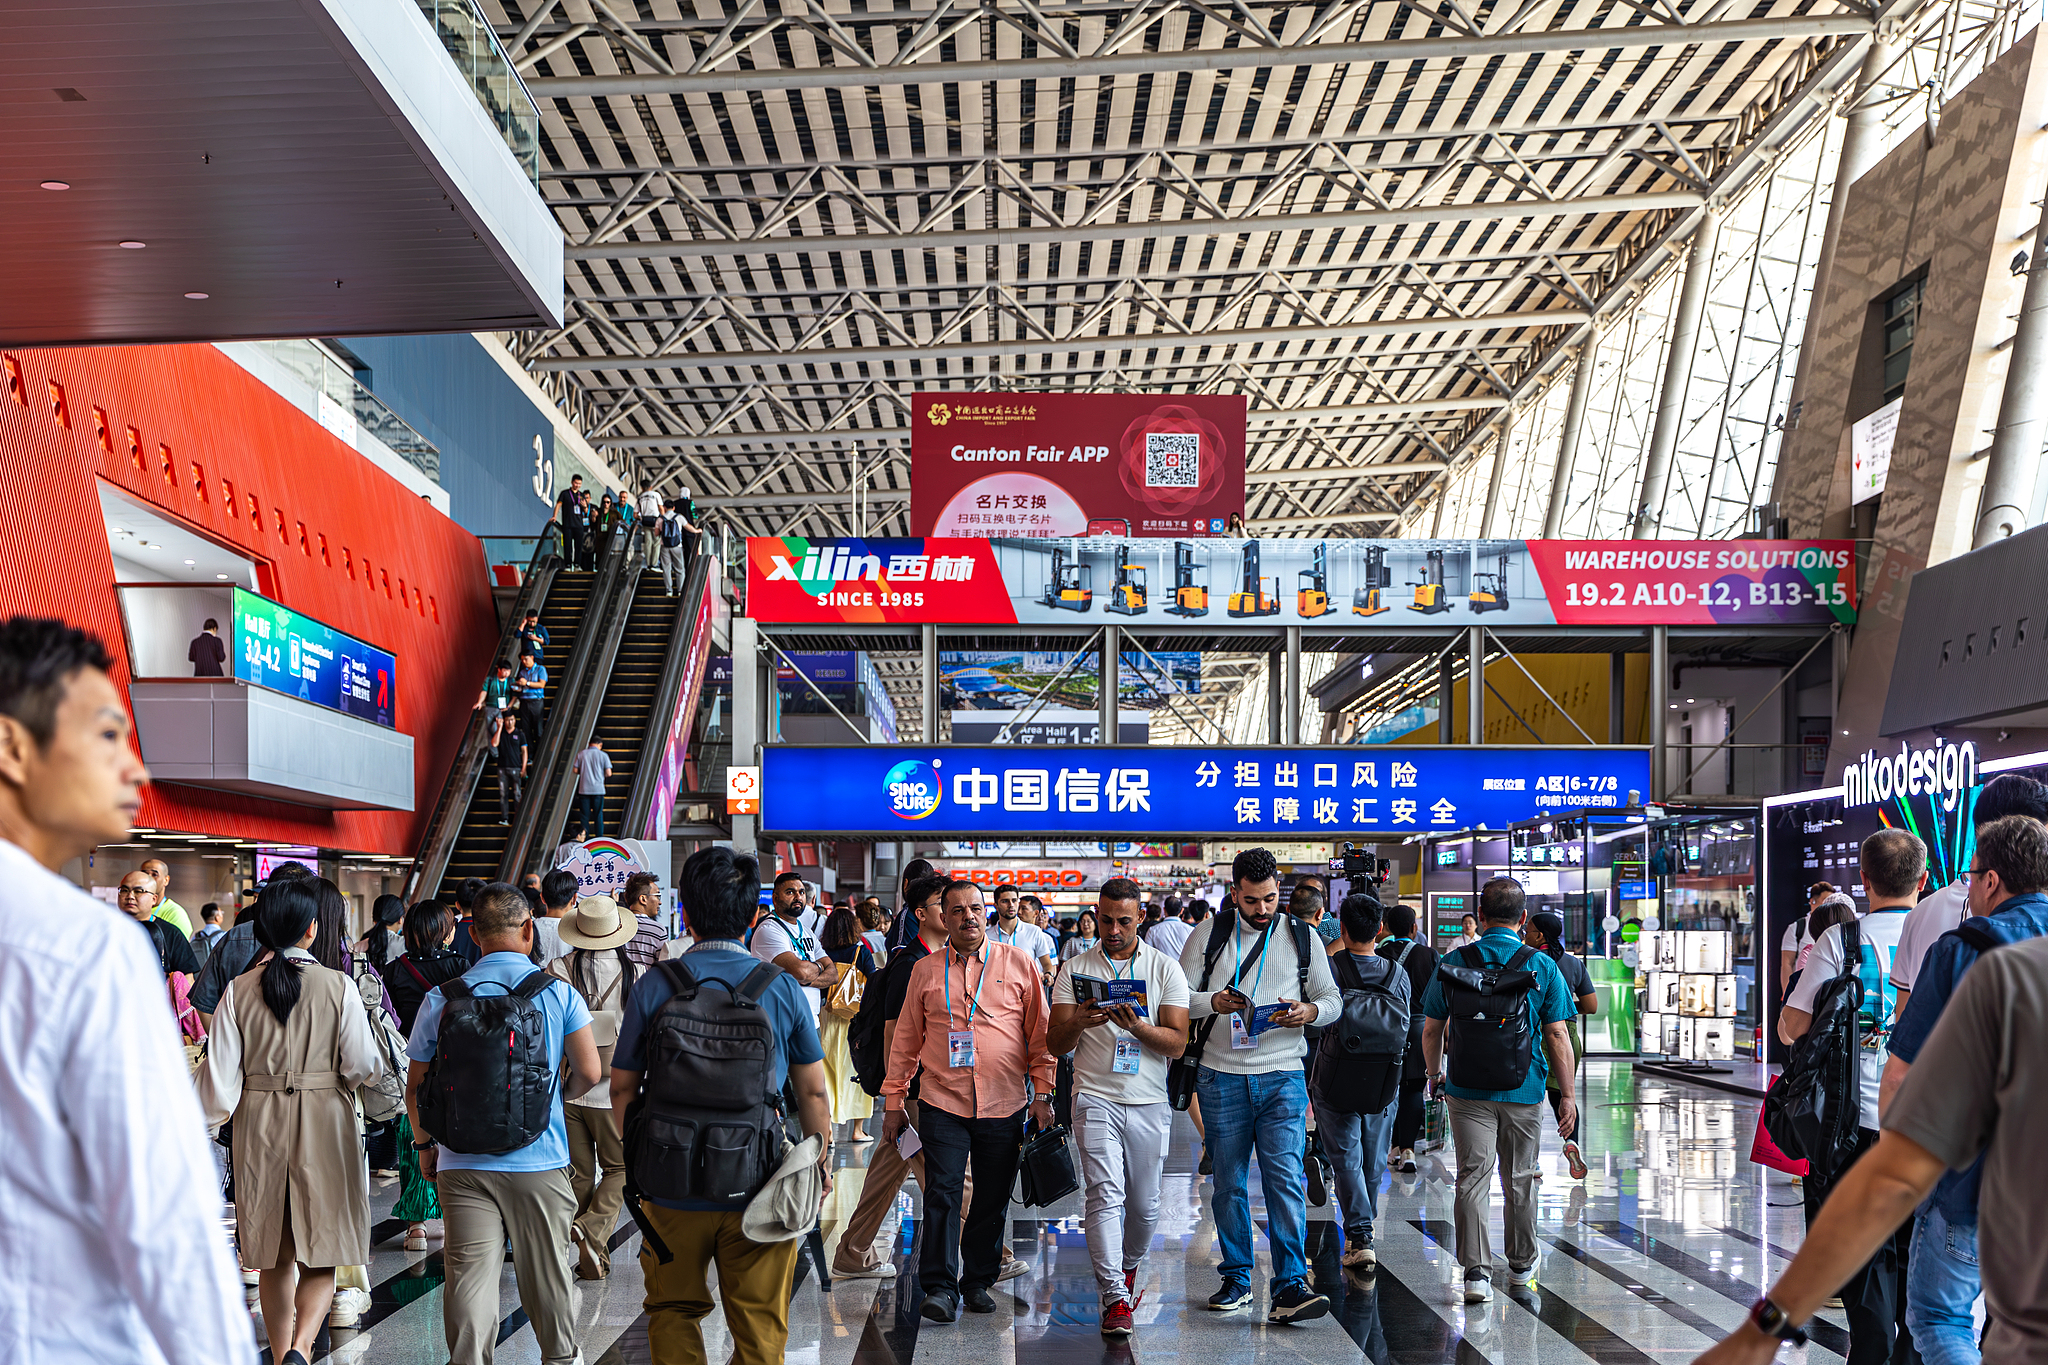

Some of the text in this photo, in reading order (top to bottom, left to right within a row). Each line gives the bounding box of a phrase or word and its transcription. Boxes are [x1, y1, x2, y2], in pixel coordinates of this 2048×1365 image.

[951, 445, 1110, 462] Canton Fair APP
[975, 494, 1047, 510] 名片交换
[957, 513, 1052, 525] 扫码互换电子名片
[766, 547, 976, 582] xilin 西林
[1566, 551, 1848, 570] WAREHOUSE SOLUTIONS
[818, 592, 924, 607] SINCE 1985
[1566, 583, 1846, 611] 19.2 A10-12, B13-15
[244, 636, 281, 673] 3.2-4.2
[1046, 726, 1067, 736] Hall
[1196, 761, 1418, 789] 分担出口风险
[1843, 737, 1975, 813] mikodesign
[889, 782, 927, 797] SINO
[953, 767, 1151, 812] 中国信保
[1483, 778, 1526, 791] 展区位置
[893, 796, 935, 810] SURE
[1535, 794, 1618, 808] (向前100米右侧)
[1234, 797, 1457, 826] 保障收汇安全
[1511, 846, 1584, 863] 沃吉设计
[1614, 852, 1652, 861] SERVIC
[583, 861, 615, 874] 广东省
[934, 869, 1083, 886] EROPRO
